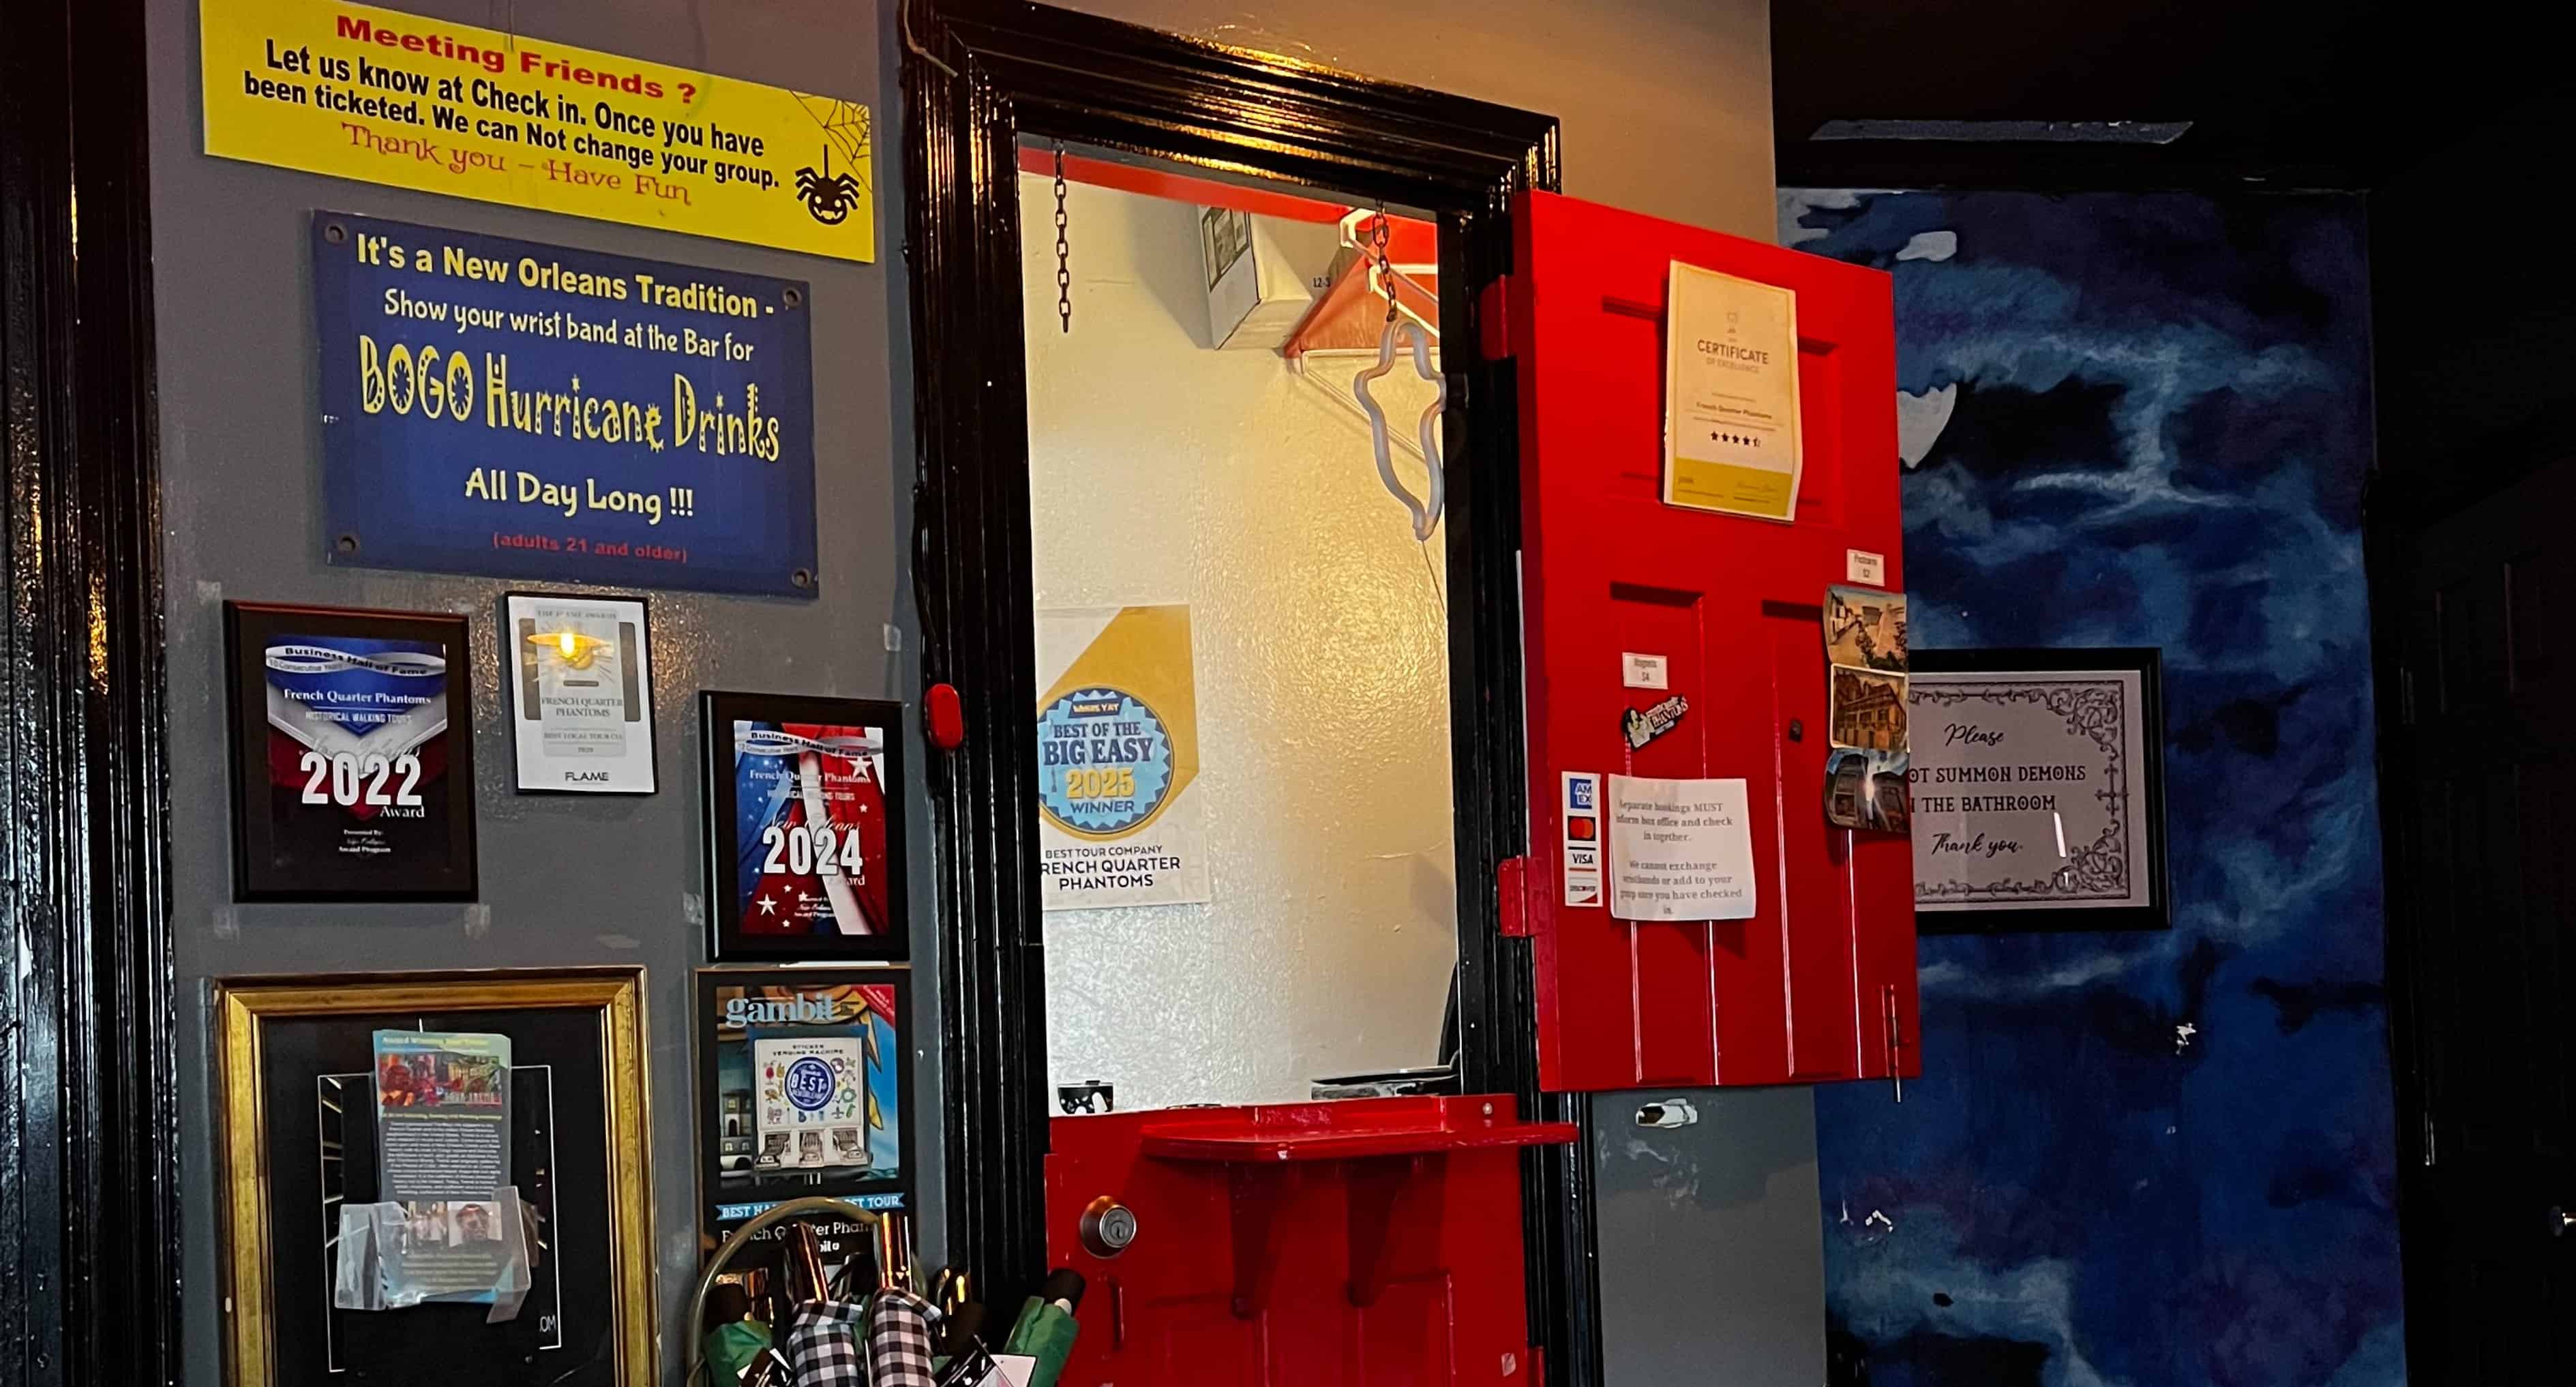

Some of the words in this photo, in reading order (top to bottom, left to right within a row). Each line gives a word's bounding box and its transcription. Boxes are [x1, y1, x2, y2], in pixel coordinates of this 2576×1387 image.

[337, 15, 504, 72] Meeting
[521, 51, 664, 99] Friends
[678, 83, 696, 103] ?
[267, 39, 311, 74] Let
[319, 57, 350, 81] us
[359, 57, 430, 95] know
[438, 76, 464, 103] at
[472, 78, 550, 118] Check
[558, 95, 586, 125] in.
[595, 102, 655, 136] Once
[663, 121, 703, 147] you
[711, 123, 764, 156] have
[244, 70, 306, 104] been
[314, 85, 425, 125] ticketed.
[432, 104, 468, 133] We
[476, 119, 518, 143] can
[526, 122, 567, 151] Not
[573, 133, 654, 169] change
[661, 151, 708, 175] your
[715, 161, 779, 191] group.
[342, 121, 443, 166] Thank
[449, 147, 507, 175] you
[541, 159, 621, 190] Have
[635, 174, 691, 206] Fun
[357, 233, 405, 269] It's
[416, 250, 432, 273] a
[444, 246, 509, 283] New
[518, 257, 627, 300] Orleans
[635, 274, 758, 318] Tradition
[385, 288, 447, 321] Show
[454, 305, 504, 333] your
[509, 311, 561, 339] wrist
[567, 312, 617, 344] band
[624, 323, 642, 349] at
[647, 324, 678, 352] the
[683, 328, 719, 357] Bar
[724, 332, 753, 361] for
[1697, 339, 1769, 365] CERTIFICATE
[359, 335, 474, 421] BOGO
[485, 352, 665, 453] Hurricane
[674, 372, 780, 462] Drinks
[464, 467, 507, 501] All
[517, 472, 578, 517] Day
[586, 479, 661, 525] Long
[670, 487, 693, 516] !!!
[492, 531, 560, 551] (adults
[567, 537, 587, 552] 21
[595, 543, 628, 556] and
[635, 546, 687, 563] older)
[285, 647, 343, 661] Business
[346, 654, 373, 668] Hall
[374, 661, 389, 671] of
[392, 666, 427, 675] Fame
[284, 689, 323, 701] French
[327, 691, 372, 703] Quarter
[375, 692, 431, 704] Phantoms
[581, 698, 622, 706] QUARTER
[305, 711, 349, 722] HISTORICAL
[353, 713, 386, 723] WALKING
[556, 708, 610, 717] PHANTOMS
[1054, 724, 1088, 738] BEST
[1092, 723, 1109, 737] OF
[1113, 721, 1141, 736] THE
[1944, 723, 2005, 746] Please
[751, 732, 799, 745] Business
[801, 739, 824, 751] Hall
[839, 749, 868, 757] Fame
[1043, 740, 1085, 765] BIG
[1091, 738, 1154, 764] EASY
[300, 751, 423, 806] 2022
[565, 772, 609, 781] FLAME
[1066, 767, 1136, 799] 2025
[1909, 768, 1930, 783] OT
[1936, 767, 2011, 784] SUMMON
[2018, 766, 2086, 781] DEMONS
[380, 805, 425, 818] Award
[1070, 801, 1135, 814] WINNER
[1619, 801, 1653, 811] Separate
[1654, 802, 1690, 814] bookings
[1694, 803, 1723, 812] MUST
[1921, 797, 1954, 812] THE
[1962, 795, 2056, 811] BATHROOM
[1641, 816, 1655, 824] box
[1657, 817, 1678, 826] office
[1681, 818, 1701, 826] and
[1703, 816, 1733, 826] check
[1643, 831, 1651, 840] in
[1931, 833, 1986, 856] Thank
[762, 826, 863, 875] 2024
[1045, 848, 1073, 859] BEST
[1074, 848, 1106, 857] TOUR
[1107, 845, 1163, 856] COMPANY
[1572, 854, 1593, 864] VISA
[1040, 861, 1097, 875] RENCH
[1101, 857, 1181, 873] QUARTER
[1669, 862, 1717, 871] exchange
[1059, 874, 1154, 890] PHANTOMS
[1673, 876, 1692, 885] add
[1695, 876, 1705, 884] to
[1708, 876, 1733, 886] your
[1655, 892, 1671, 901] you
[1673, 890, 1698, 899] have
[1700, 889, 1743, 899] checked
[725, 993, 833, 1028] gambit
[791, 1073, 825, 1092] BEST
[721, 1206, 750, 1219] BEST
[867, 1195, 899, 1208] TOUR
